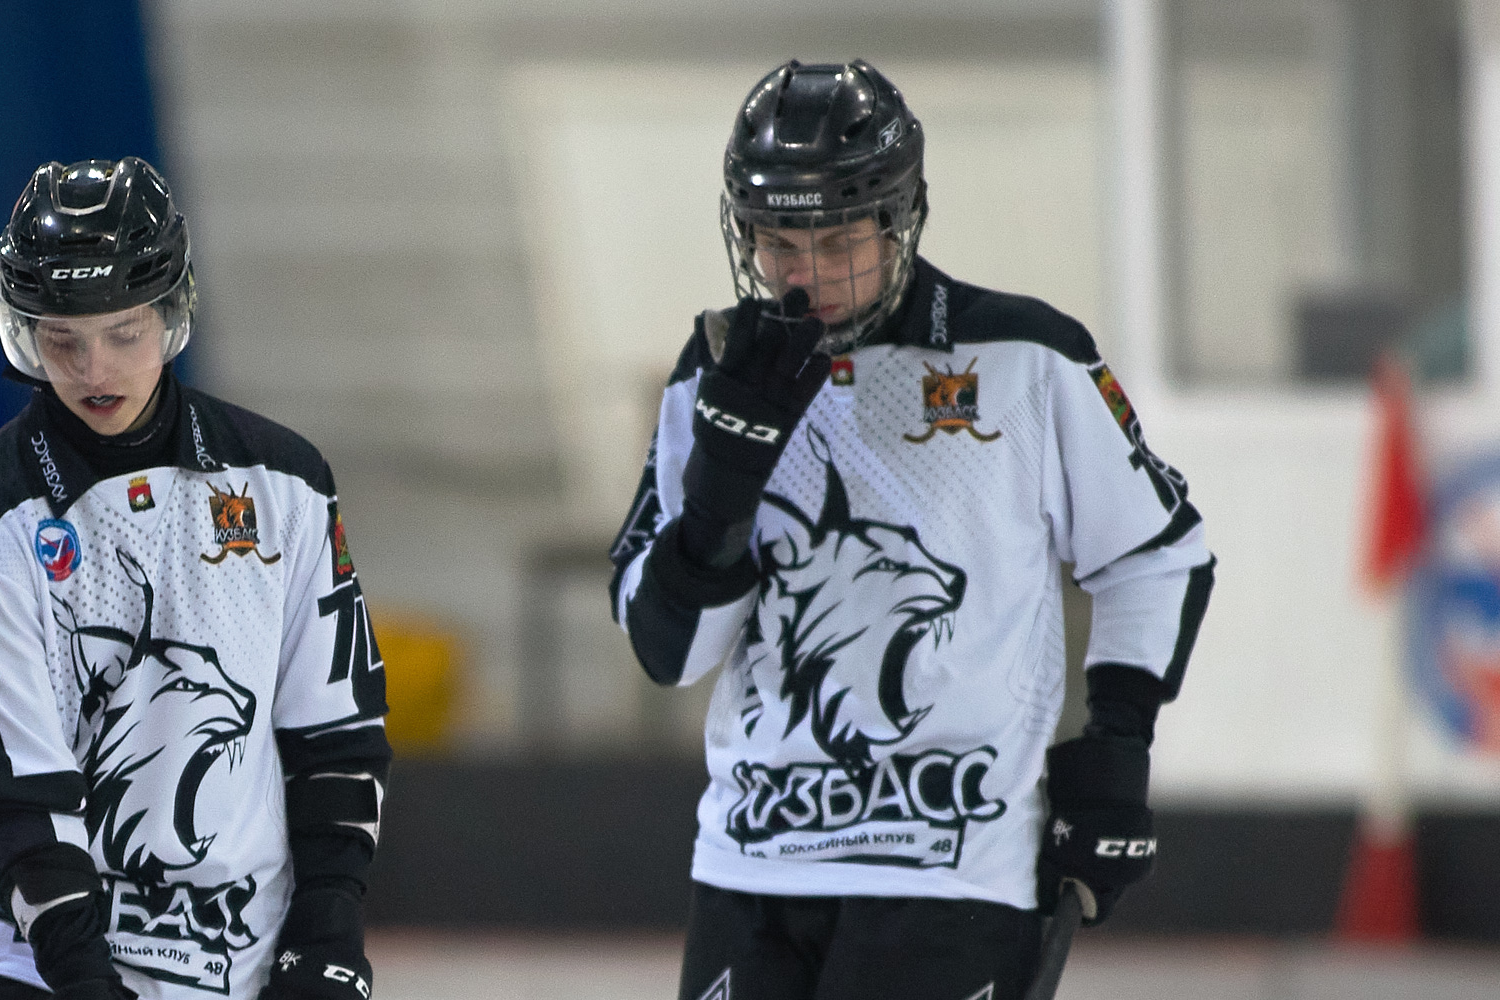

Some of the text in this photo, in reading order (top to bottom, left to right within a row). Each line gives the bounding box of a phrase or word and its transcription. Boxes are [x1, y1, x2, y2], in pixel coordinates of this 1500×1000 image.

[767, 193, 822, 206] КУЗБАСС
[51, 265, 113, 280] CCM
[696, 398, 779, 444] CCM
[873, 832, 916, 846] КЛУБ
[929, 838, 953, 853] 48
[203, 960, 224, 975] 48
